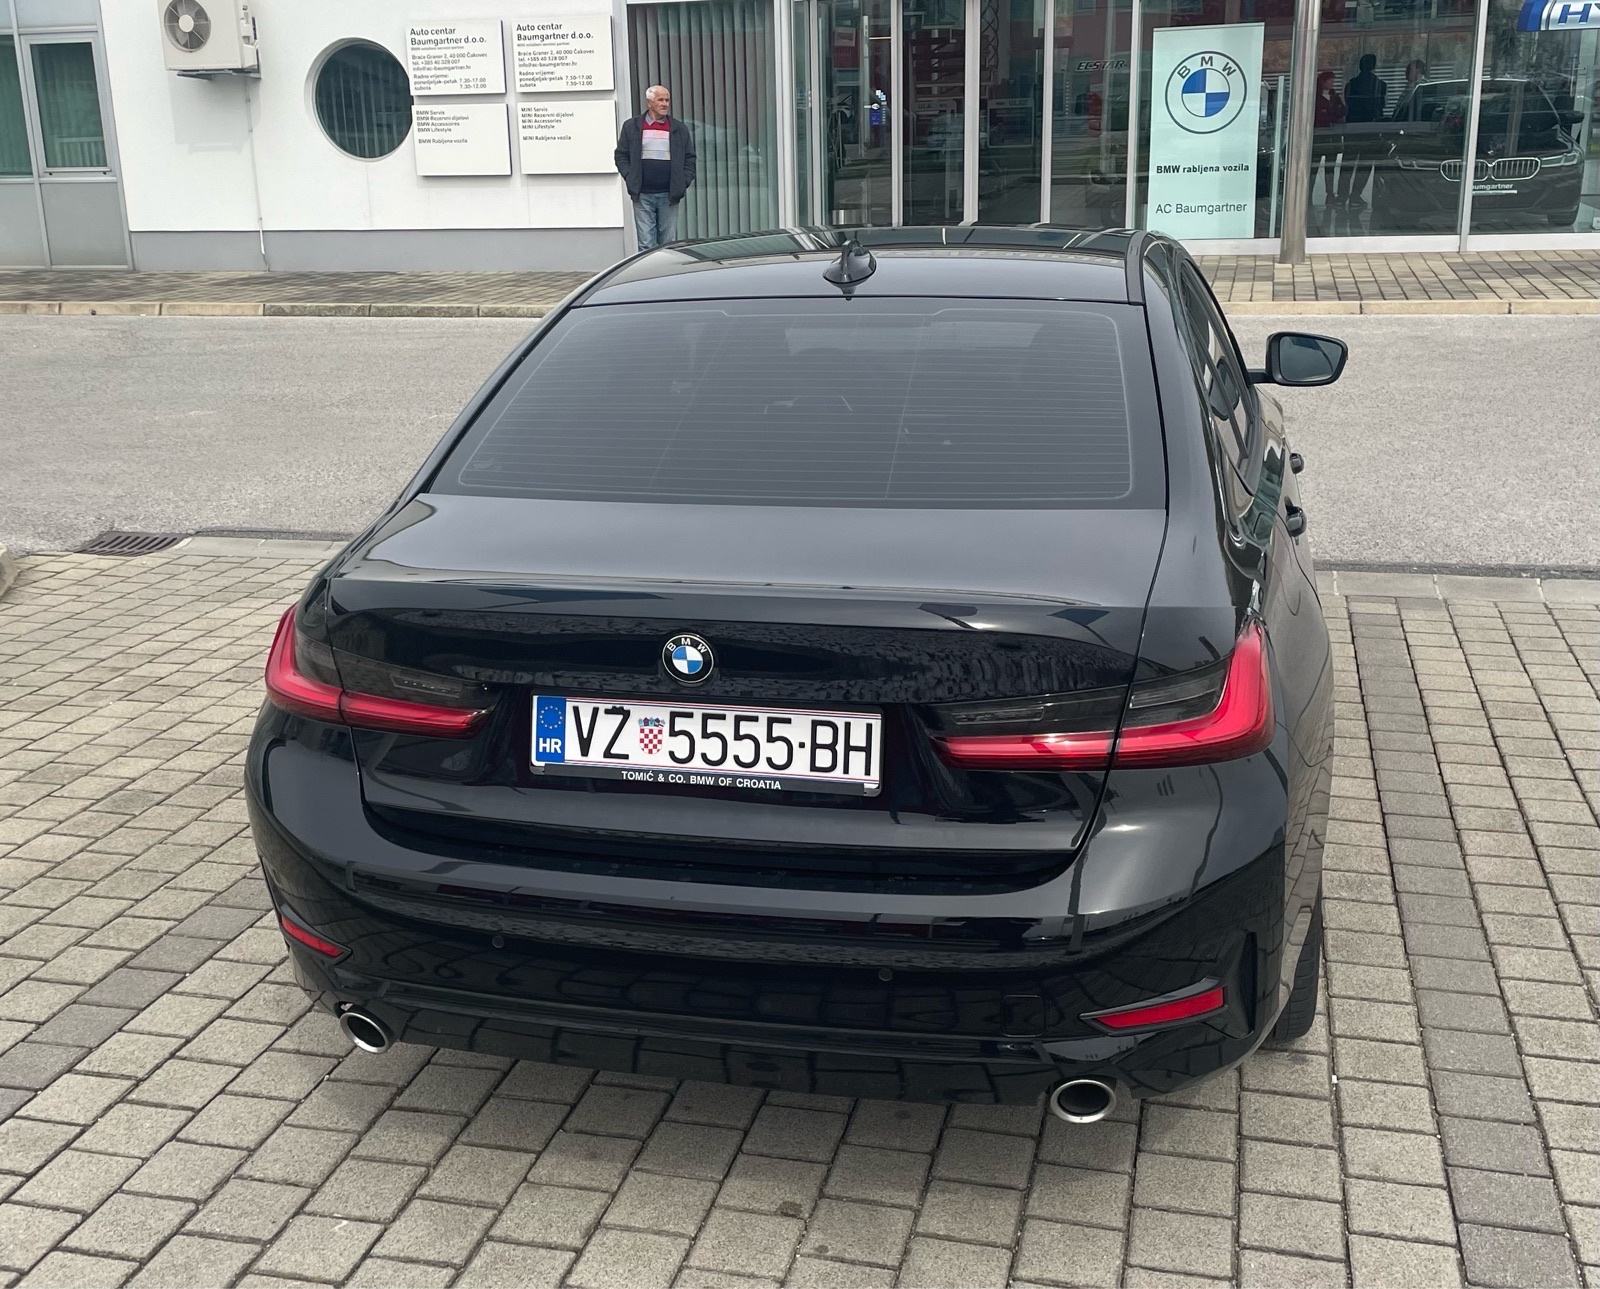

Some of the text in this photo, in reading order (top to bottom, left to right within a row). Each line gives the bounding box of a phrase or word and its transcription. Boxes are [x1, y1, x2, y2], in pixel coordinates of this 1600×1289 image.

[431, 27, 456, 35] centar
[517, 32, 569, 42] Baumgartner
[410, 36, 462, 46] Baumgartner
[1177, 56, 1236, 79] BMW
[1156, 163, 1250, 174] BMW rabljena vozila
[1156, 203, 1248, 215] AC Baumgartner
[666, 636, 708, 654] BMW
[572, 705, 631, 760] VŽ
[539, 738, 562, 753] HR
[622, 770, 782, 790] TOMIĆ & CO. BMW OF CROATIA
